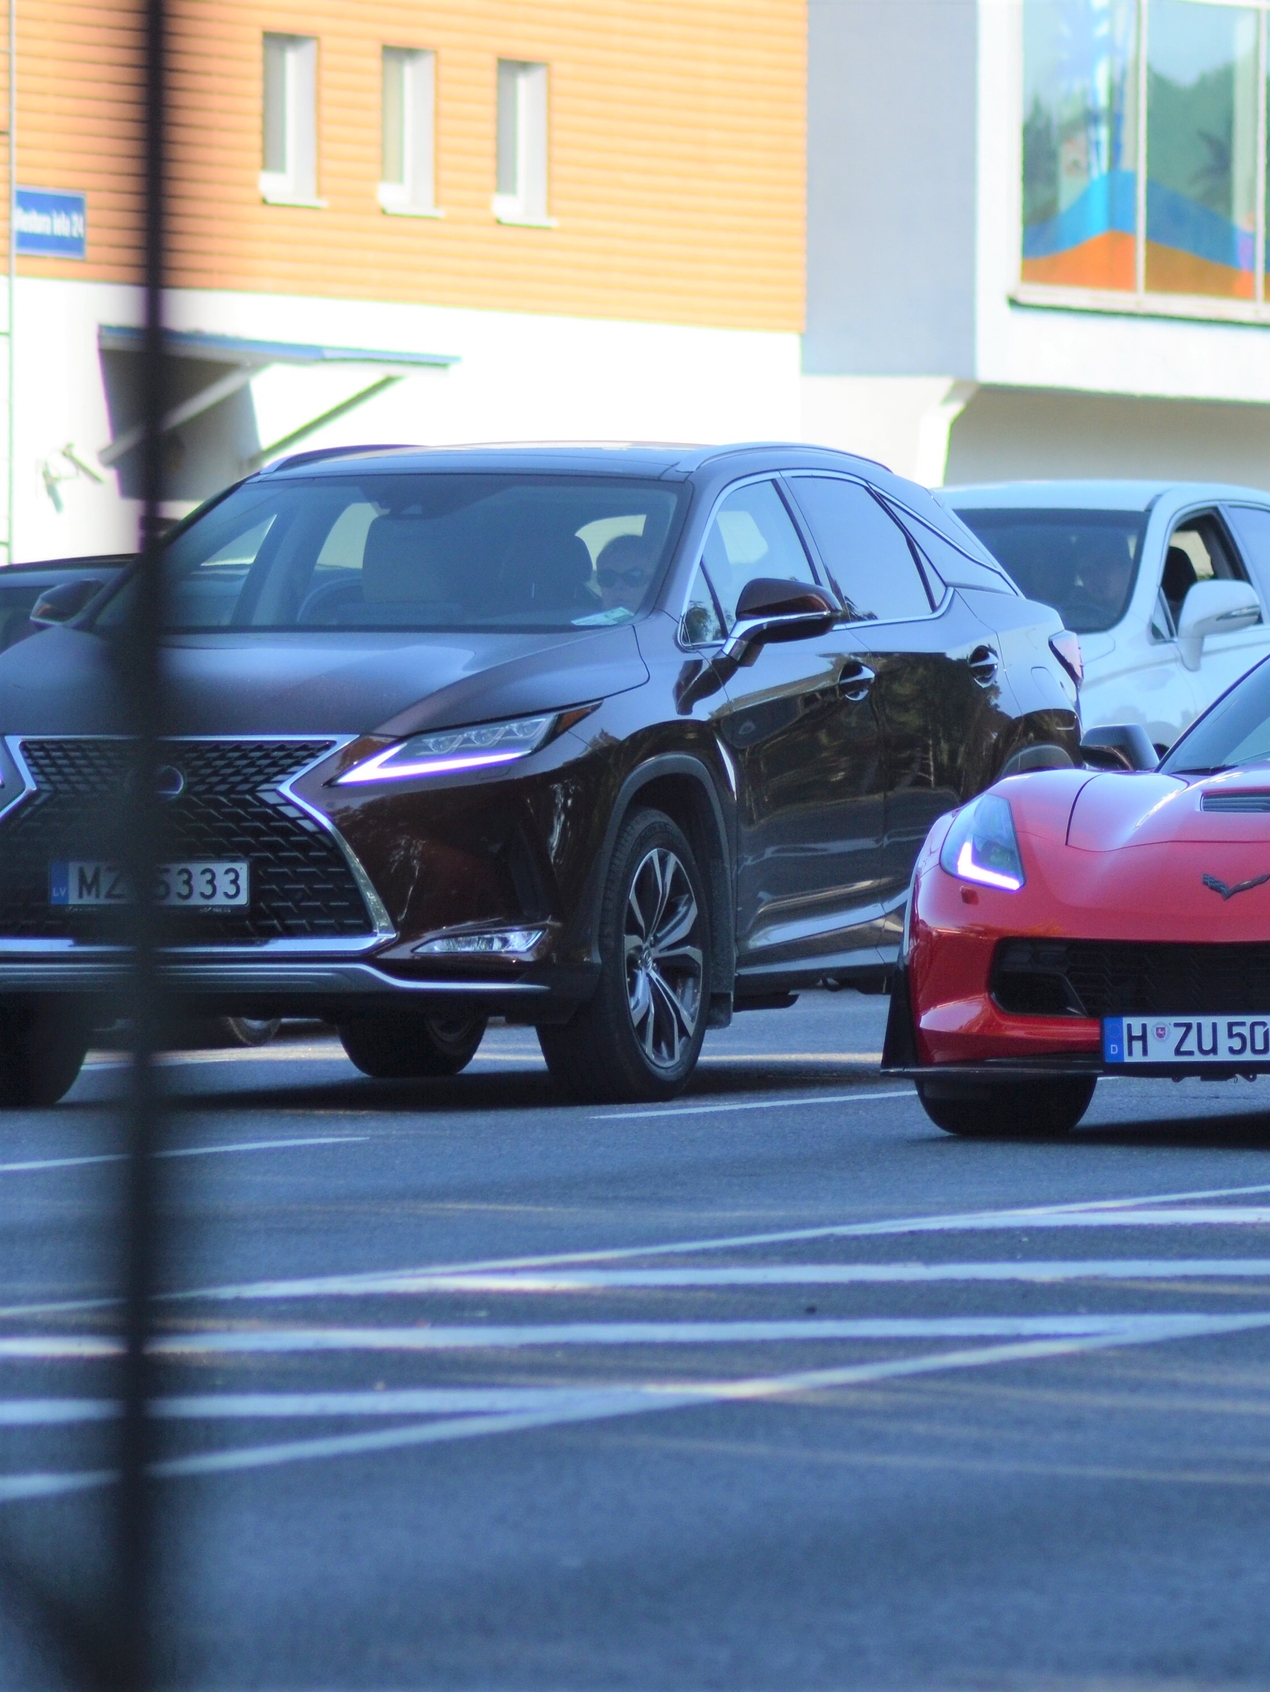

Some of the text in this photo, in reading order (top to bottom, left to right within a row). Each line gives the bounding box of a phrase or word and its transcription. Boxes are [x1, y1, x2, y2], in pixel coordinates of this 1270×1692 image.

[52, 887, 66, 897] LV
[1126, 1022, 1148, 1057] H
[1110, 1044, 1119, 1054] D
